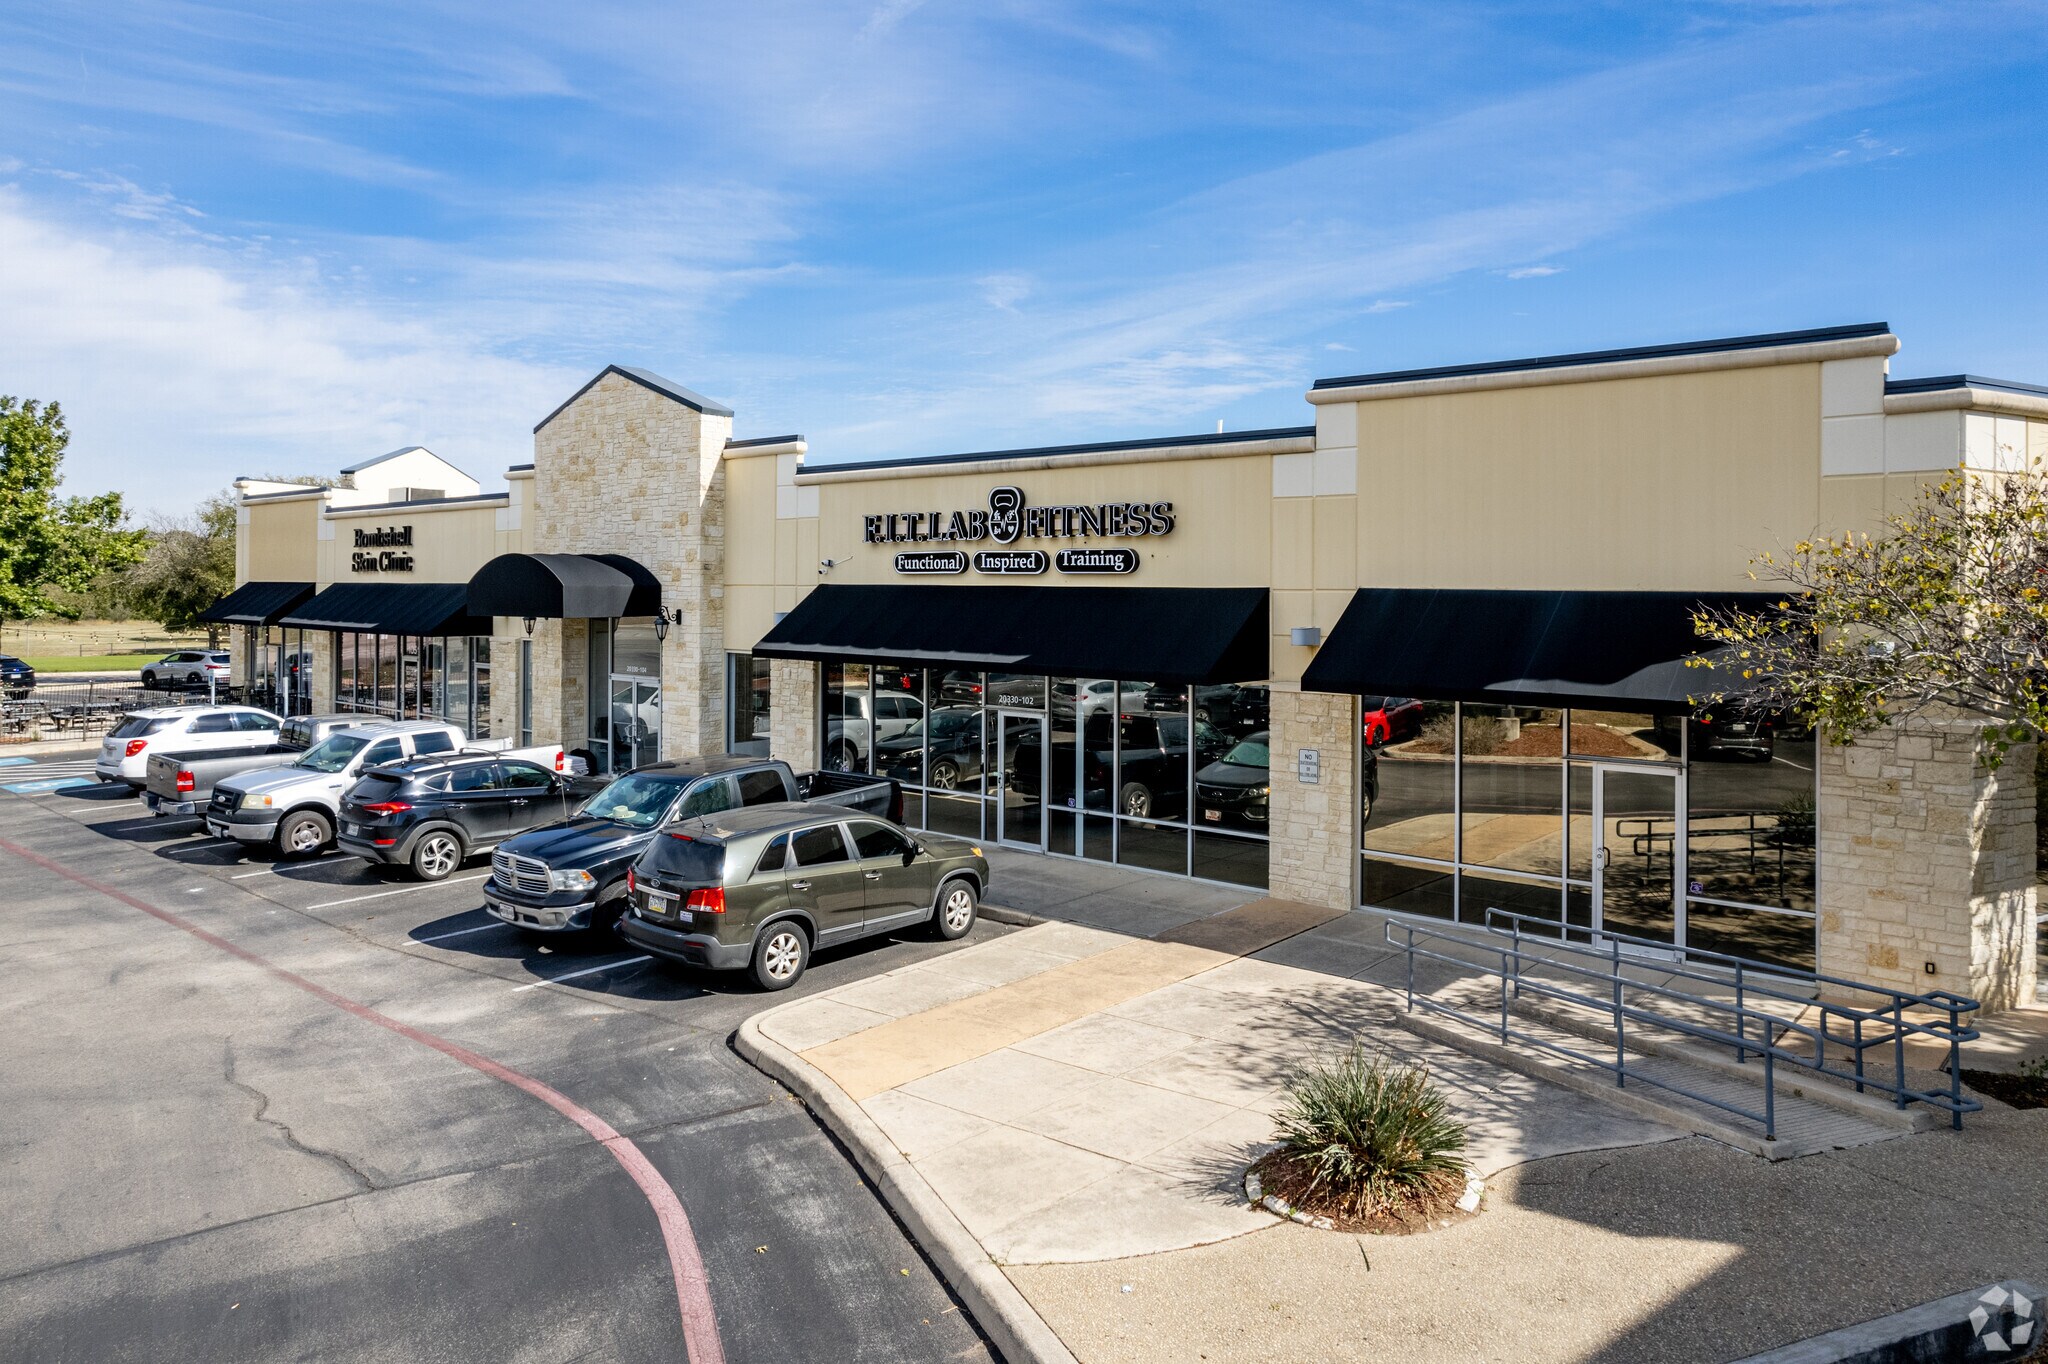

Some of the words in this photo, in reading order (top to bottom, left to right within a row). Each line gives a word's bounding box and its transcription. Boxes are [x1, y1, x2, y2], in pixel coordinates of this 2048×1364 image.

[1023, 501, 1175, 538] FITNESS
[353, 526, 412, 548] Bombshell
[352, 552, 378, 572] Skin
[379, 551, 413, 572] Clinic
[897, 555, 960, 570] Functional
[980, 553, 1036, 573] Inspired
[1061, 551, 1124, 571] Training
[998, 694, 1034, 704] 20330-102
